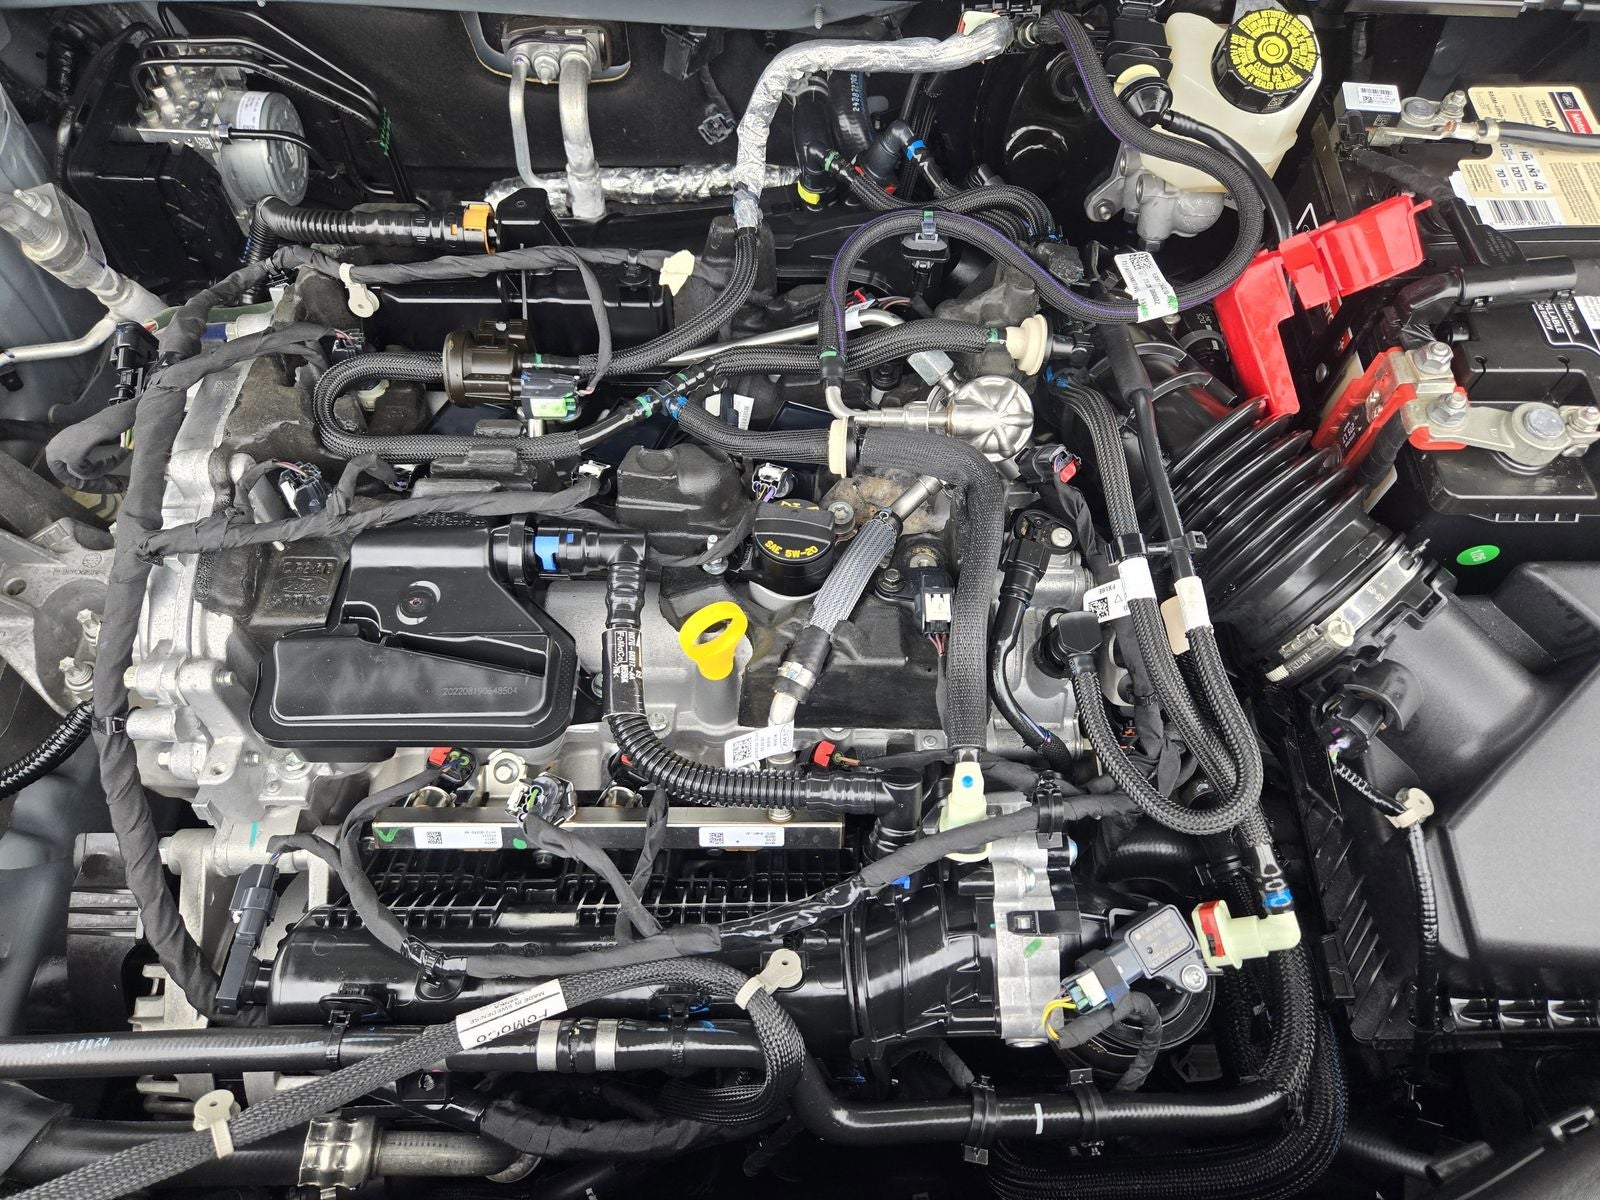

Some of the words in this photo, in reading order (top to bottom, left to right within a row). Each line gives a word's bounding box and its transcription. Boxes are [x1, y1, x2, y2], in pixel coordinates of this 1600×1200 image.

[1254, 78, 1274, 89] SEALED
[1276, 74, 1302, 90] CONTAINER
[1519, 151, 1530, 161] H6
[764, 540, 783, 555] SAE
[784, 545, 819, 558] 5W-20
[616, 631, 625, 662] FoMoCo
